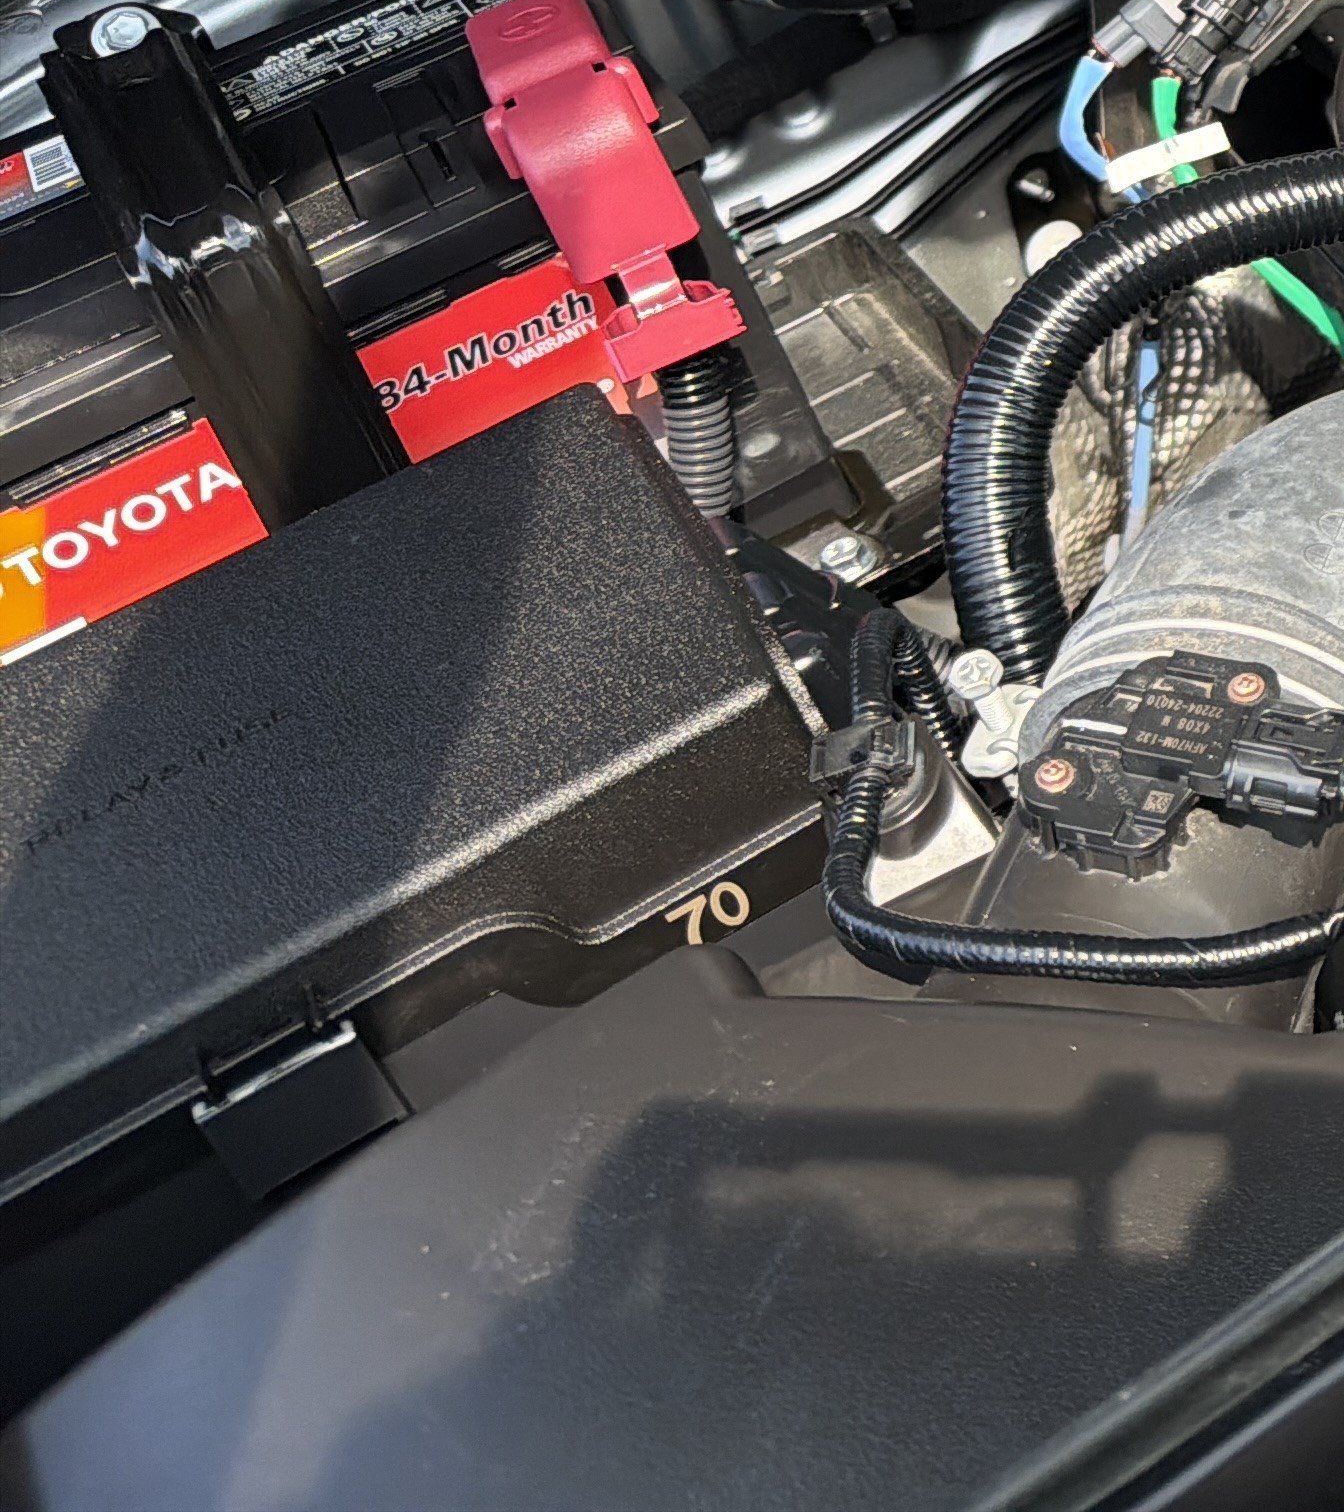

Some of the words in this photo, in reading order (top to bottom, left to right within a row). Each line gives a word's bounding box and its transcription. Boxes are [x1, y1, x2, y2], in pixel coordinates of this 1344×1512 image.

[507, 316, 598, 368] WARRANTY
[1, 462, 242, 586] TOYOTA
[665, 882, 750, 945] 70
